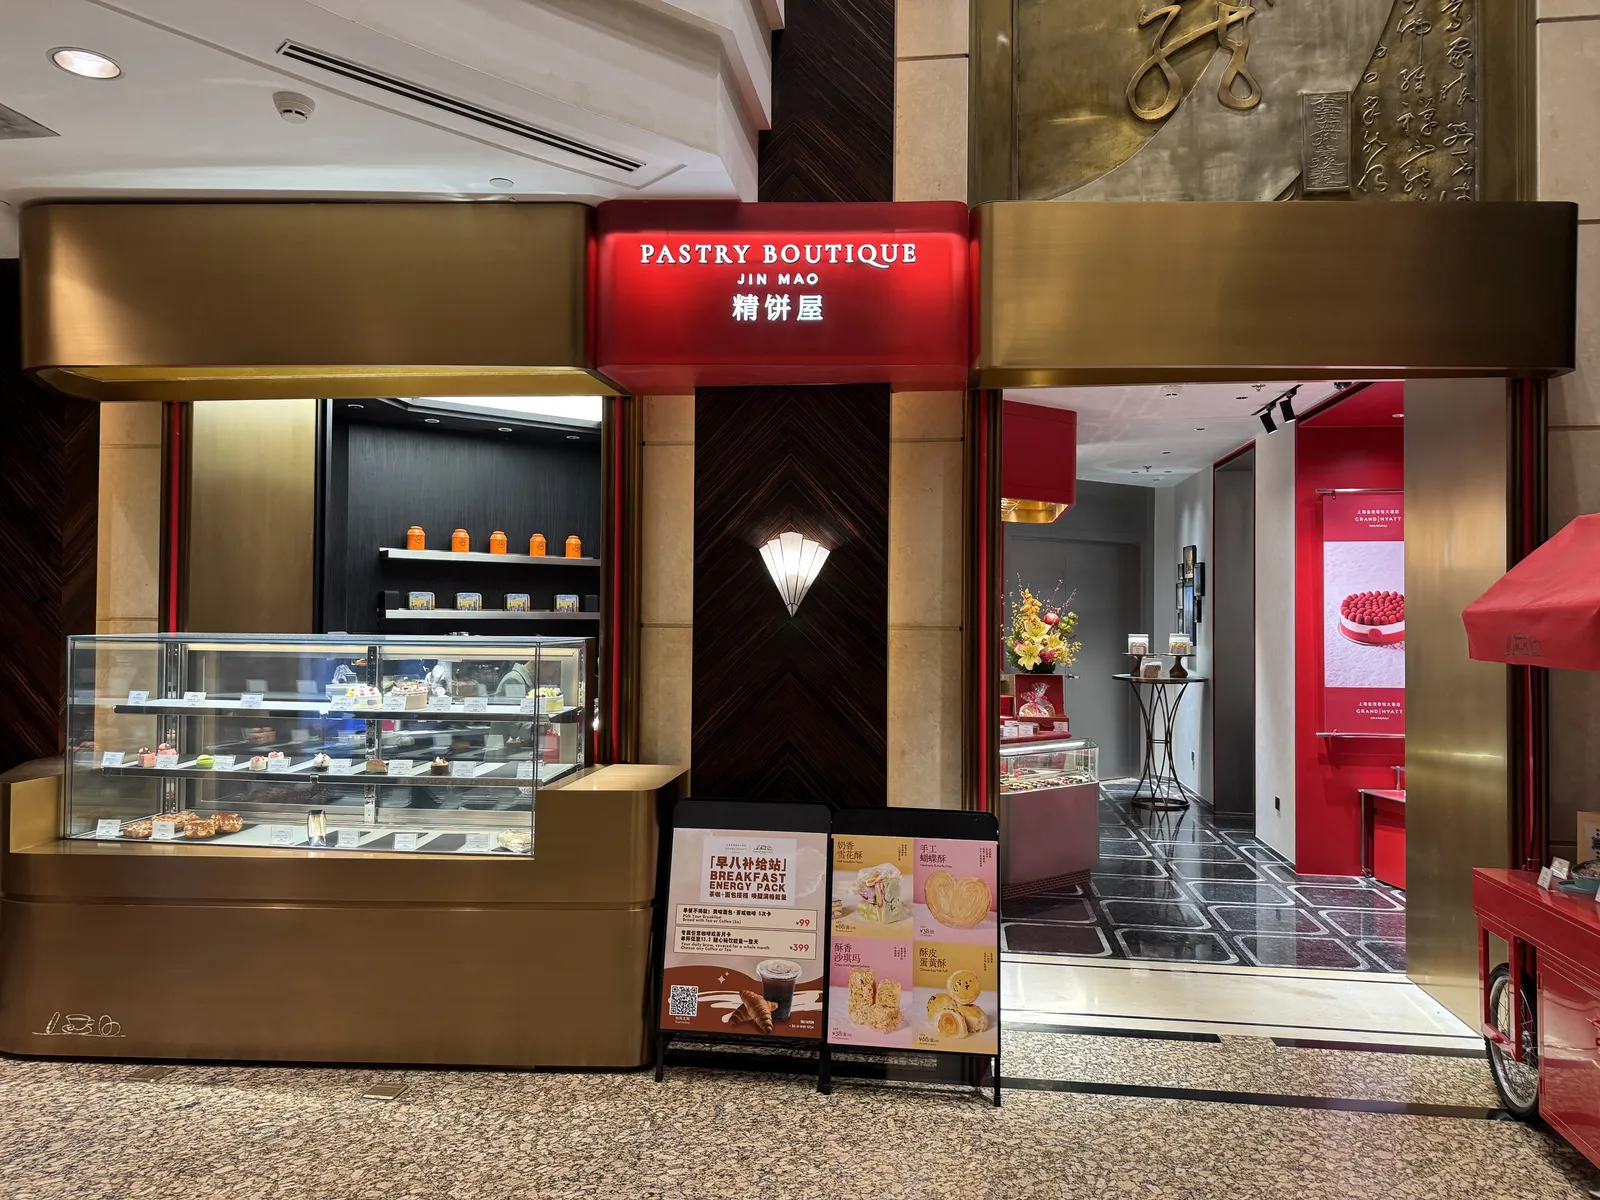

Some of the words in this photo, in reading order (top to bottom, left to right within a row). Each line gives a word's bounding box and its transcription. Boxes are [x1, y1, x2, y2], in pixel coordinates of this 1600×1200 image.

[640, 244, 751, 265] PASTRY
[763, 243, 917, 270] BOUTIQUE
[737, 273, 767, 285] JIN
[779, 273, 819, 285] MAO
[732, 294, 824, 322] 精饼屋
[837, 841, 854, 850] 奶香
[920, 844, 937, 853] 手工
[919, 853, 946, 863] 蝴蝶酥
[710, 871, 786, 883] BREAKFAST
[709, 881, 751, 891] ENERGY
[756, 883, 786, 892] PACK
[796, 919, 810, 927] ¥99
[789, 943, 809, 952] ¥399
[834, 943, 852, 953] 酥香
[834, 953, 860, 963] 沙琪玛
[919, 948, 937, 958] 酥皮
[919, 958, 947, 968] 蛋黄酥
